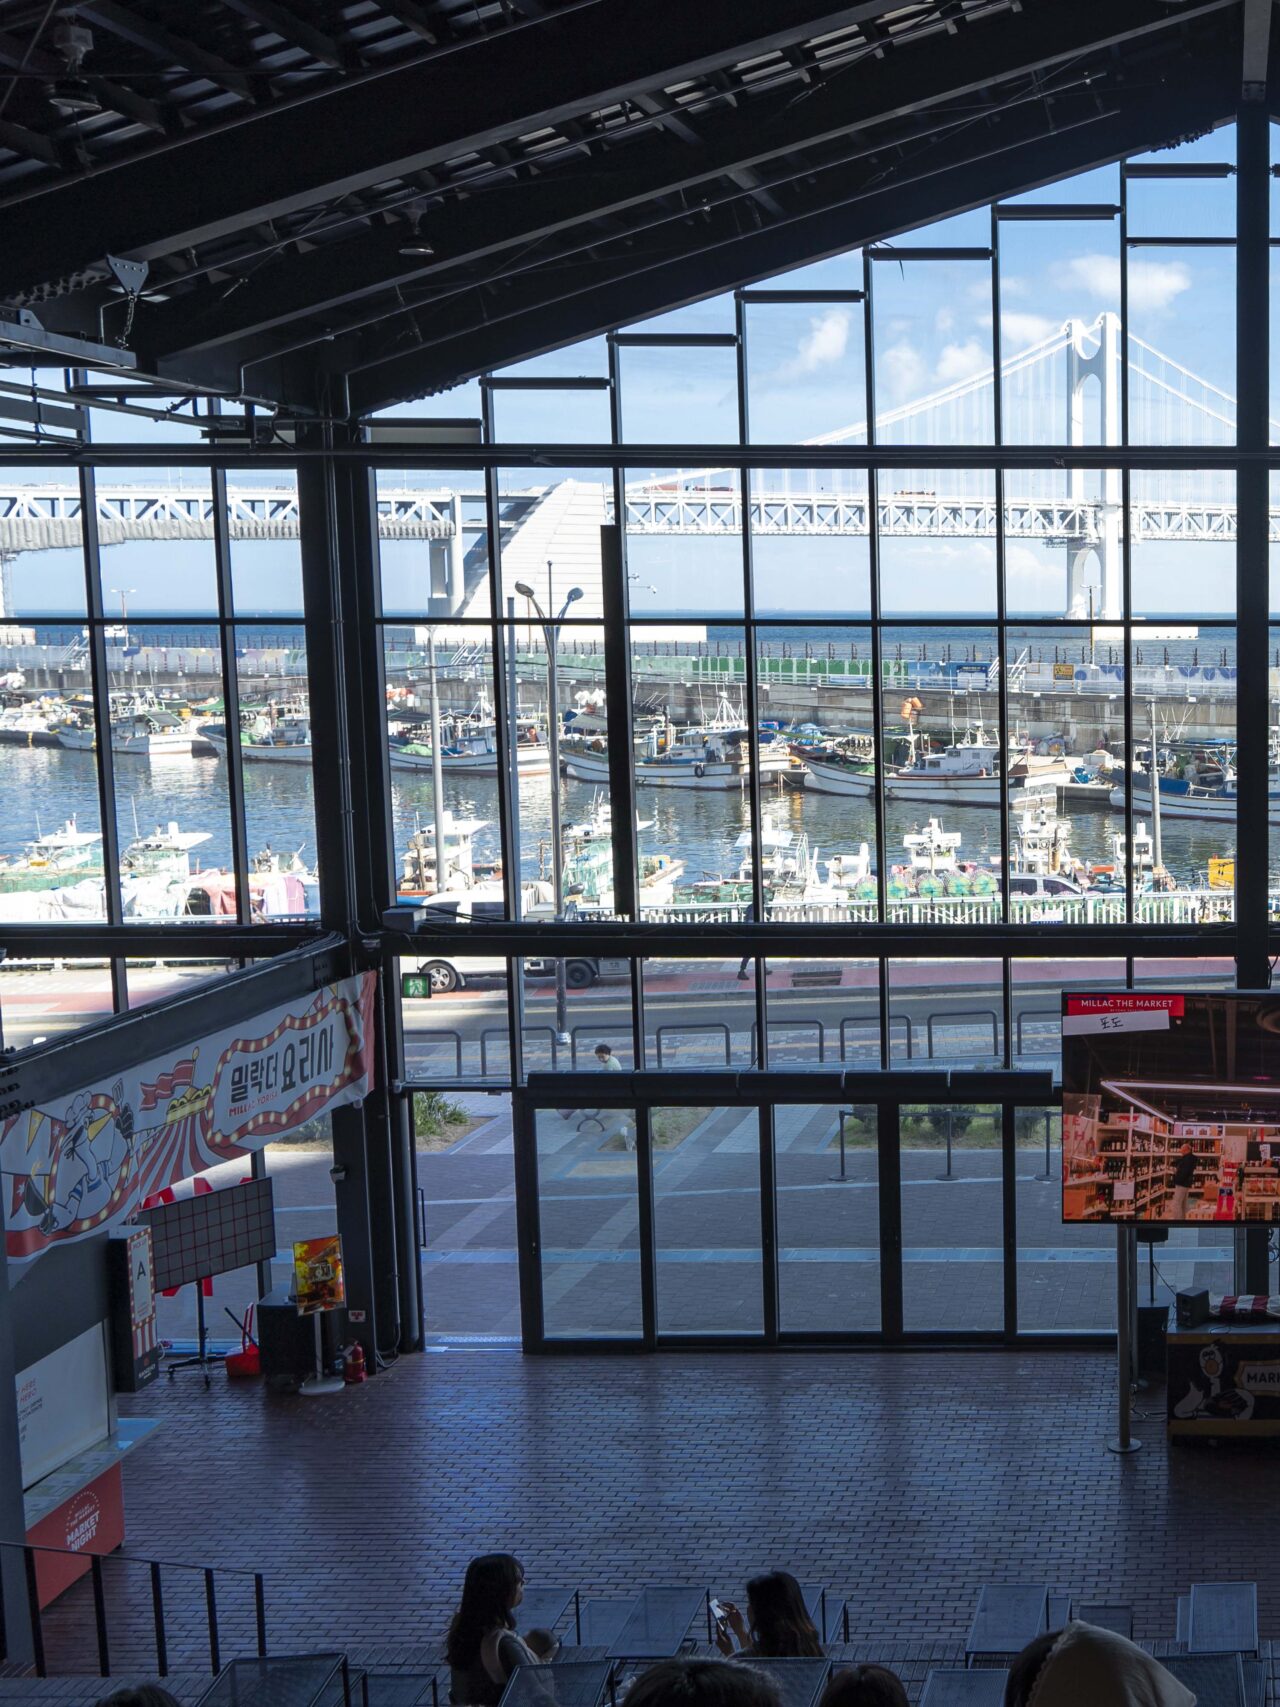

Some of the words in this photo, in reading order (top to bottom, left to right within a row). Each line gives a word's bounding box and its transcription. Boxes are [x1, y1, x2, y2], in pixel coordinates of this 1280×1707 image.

[1081, 999, 1115, 1007] MILLAC
[1116, 999, 1134, 1007] THE
[1136, 999, 1173, 1008] MARKET
[137, 1261, 146, 1280] A
[66, 1510, 100, 1545] MARKET
[70, 1524, 97, 1552] NIGHT
